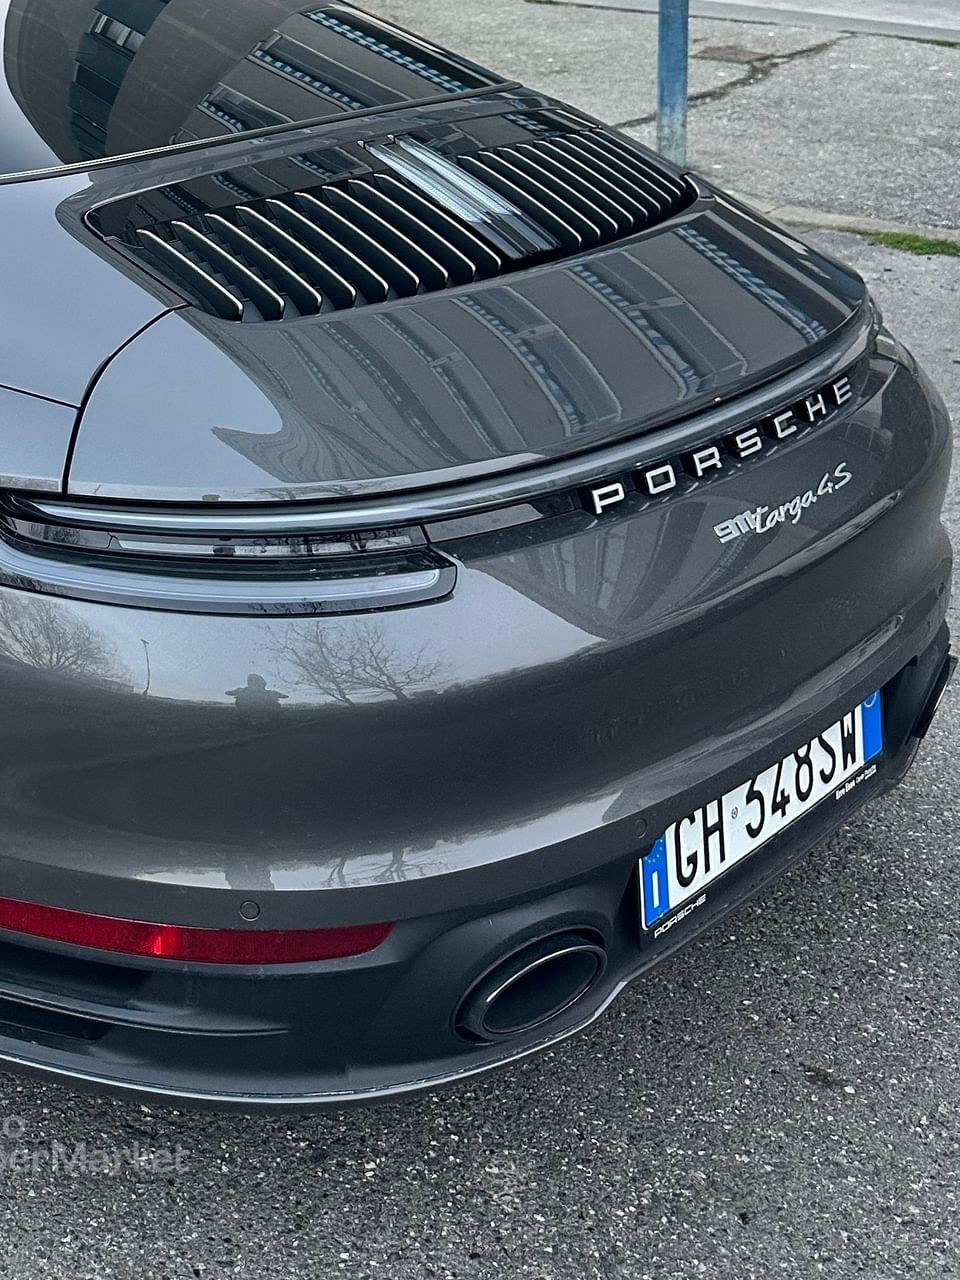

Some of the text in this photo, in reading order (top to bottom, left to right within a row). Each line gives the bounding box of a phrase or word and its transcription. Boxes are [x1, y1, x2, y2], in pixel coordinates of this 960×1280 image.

[591, 376, 853, 514] PORSCHE
[674, 798, 726, 888] GH
[654, 893, 707, 939] PORSCHE
